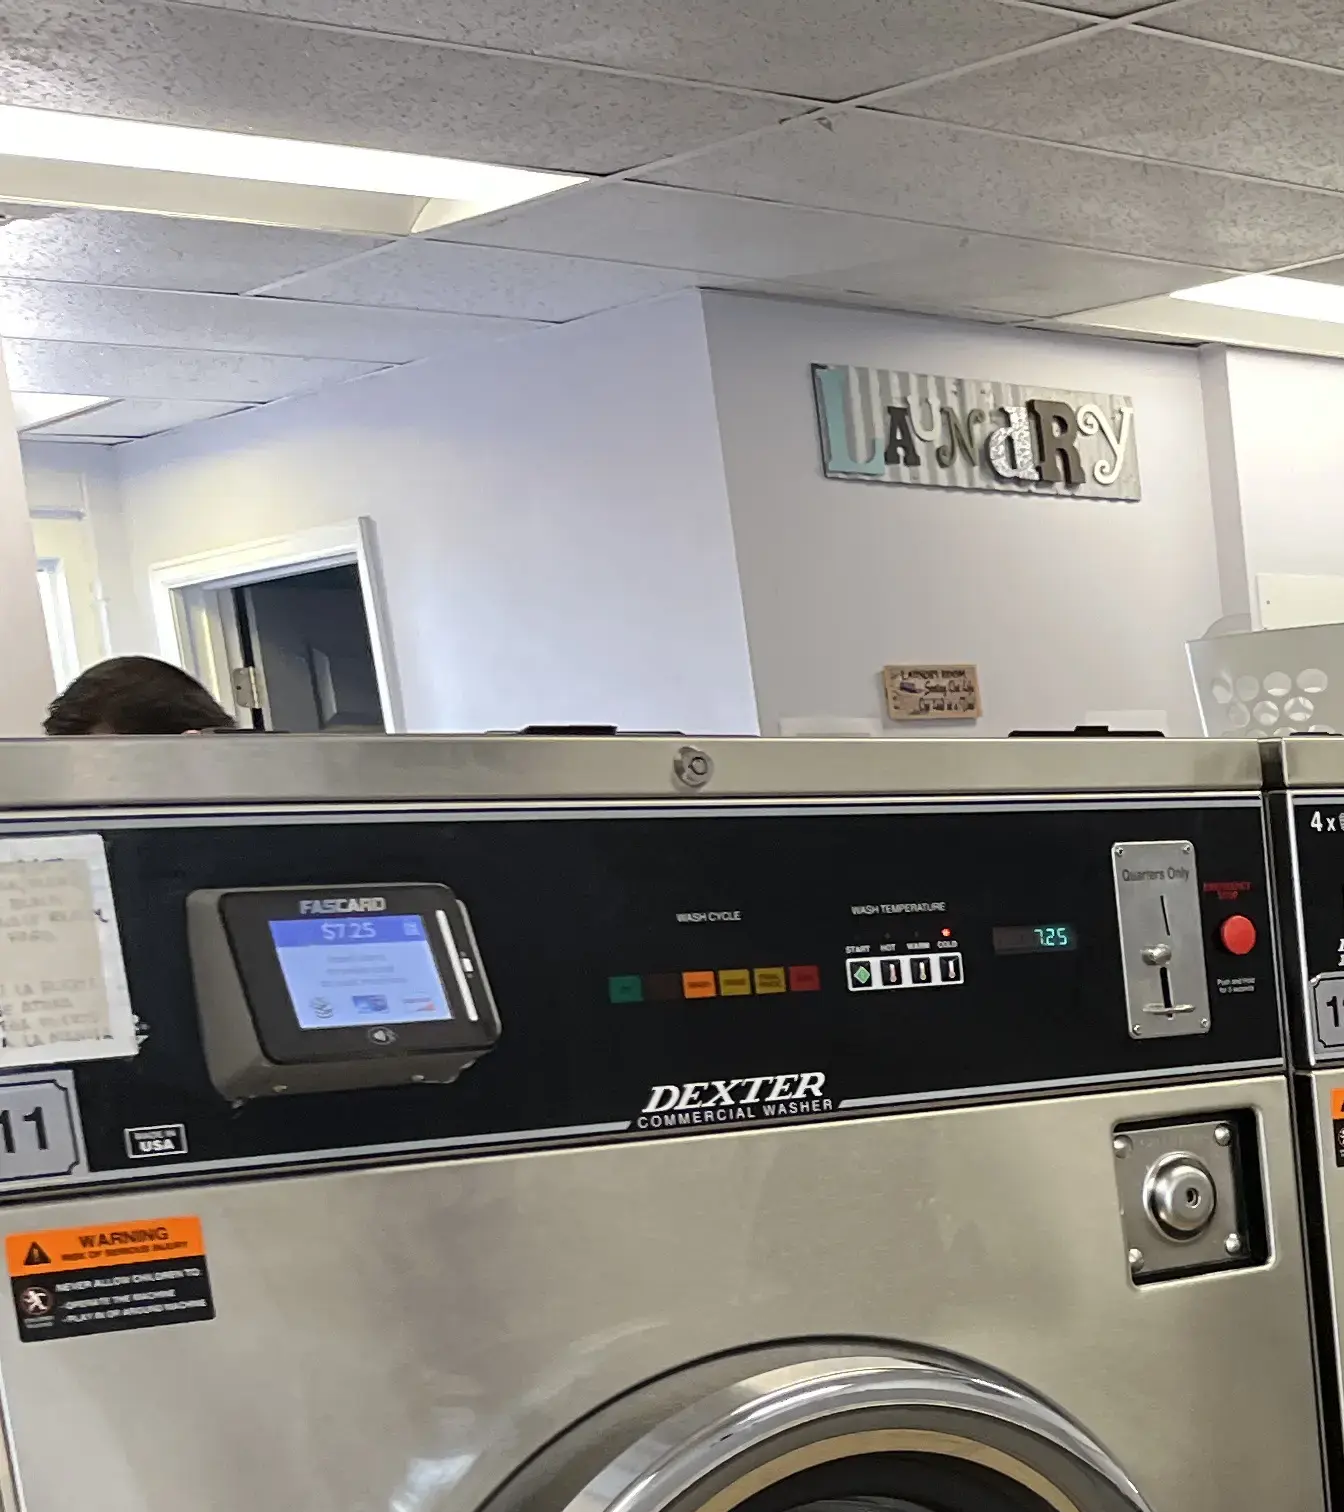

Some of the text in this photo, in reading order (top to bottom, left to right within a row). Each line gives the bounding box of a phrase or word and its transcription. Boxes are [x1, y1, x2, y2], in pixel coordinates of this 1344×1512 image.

[1121, 867, 1190, 883] Quarters Only
[299, 896, 387, 915] FASCARD
[851, 901, 947, 916] WASH TEMPERATURE
[675, 910, 742, 923] WASH CYCLE
[641, 1071, 826, 1114] DEXTER
[636, 1098, 834, 1129] COMMERCIAL WASHER
[0, 1106, 49, 1154] 11
[138, 1138, 176, 1153] USA
[78, 1226, 169, 1249] WARNING
